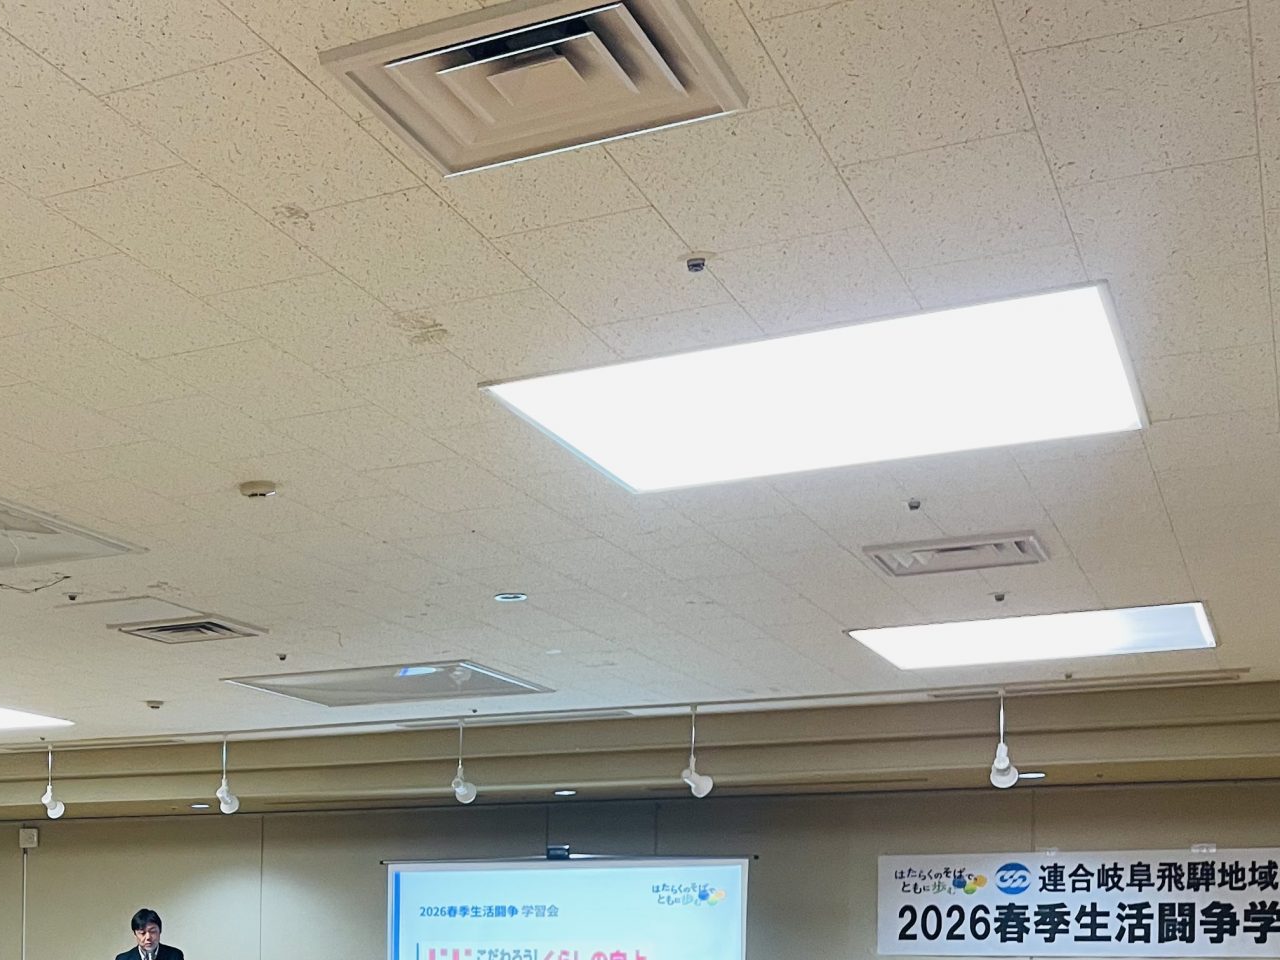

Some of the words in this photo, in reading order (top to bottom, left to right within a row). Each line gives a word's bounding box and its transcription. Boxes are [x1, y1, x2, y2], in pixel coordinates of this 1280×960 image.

[1039, 859, 1279, 893] 連合岐阜飛騨地域
[419, 905, 519, 918] 2026春季生活闘争
[521, 904, 559, 917] 学習会
[898, 901, 1280, 944] 2026春季生活闘争学
